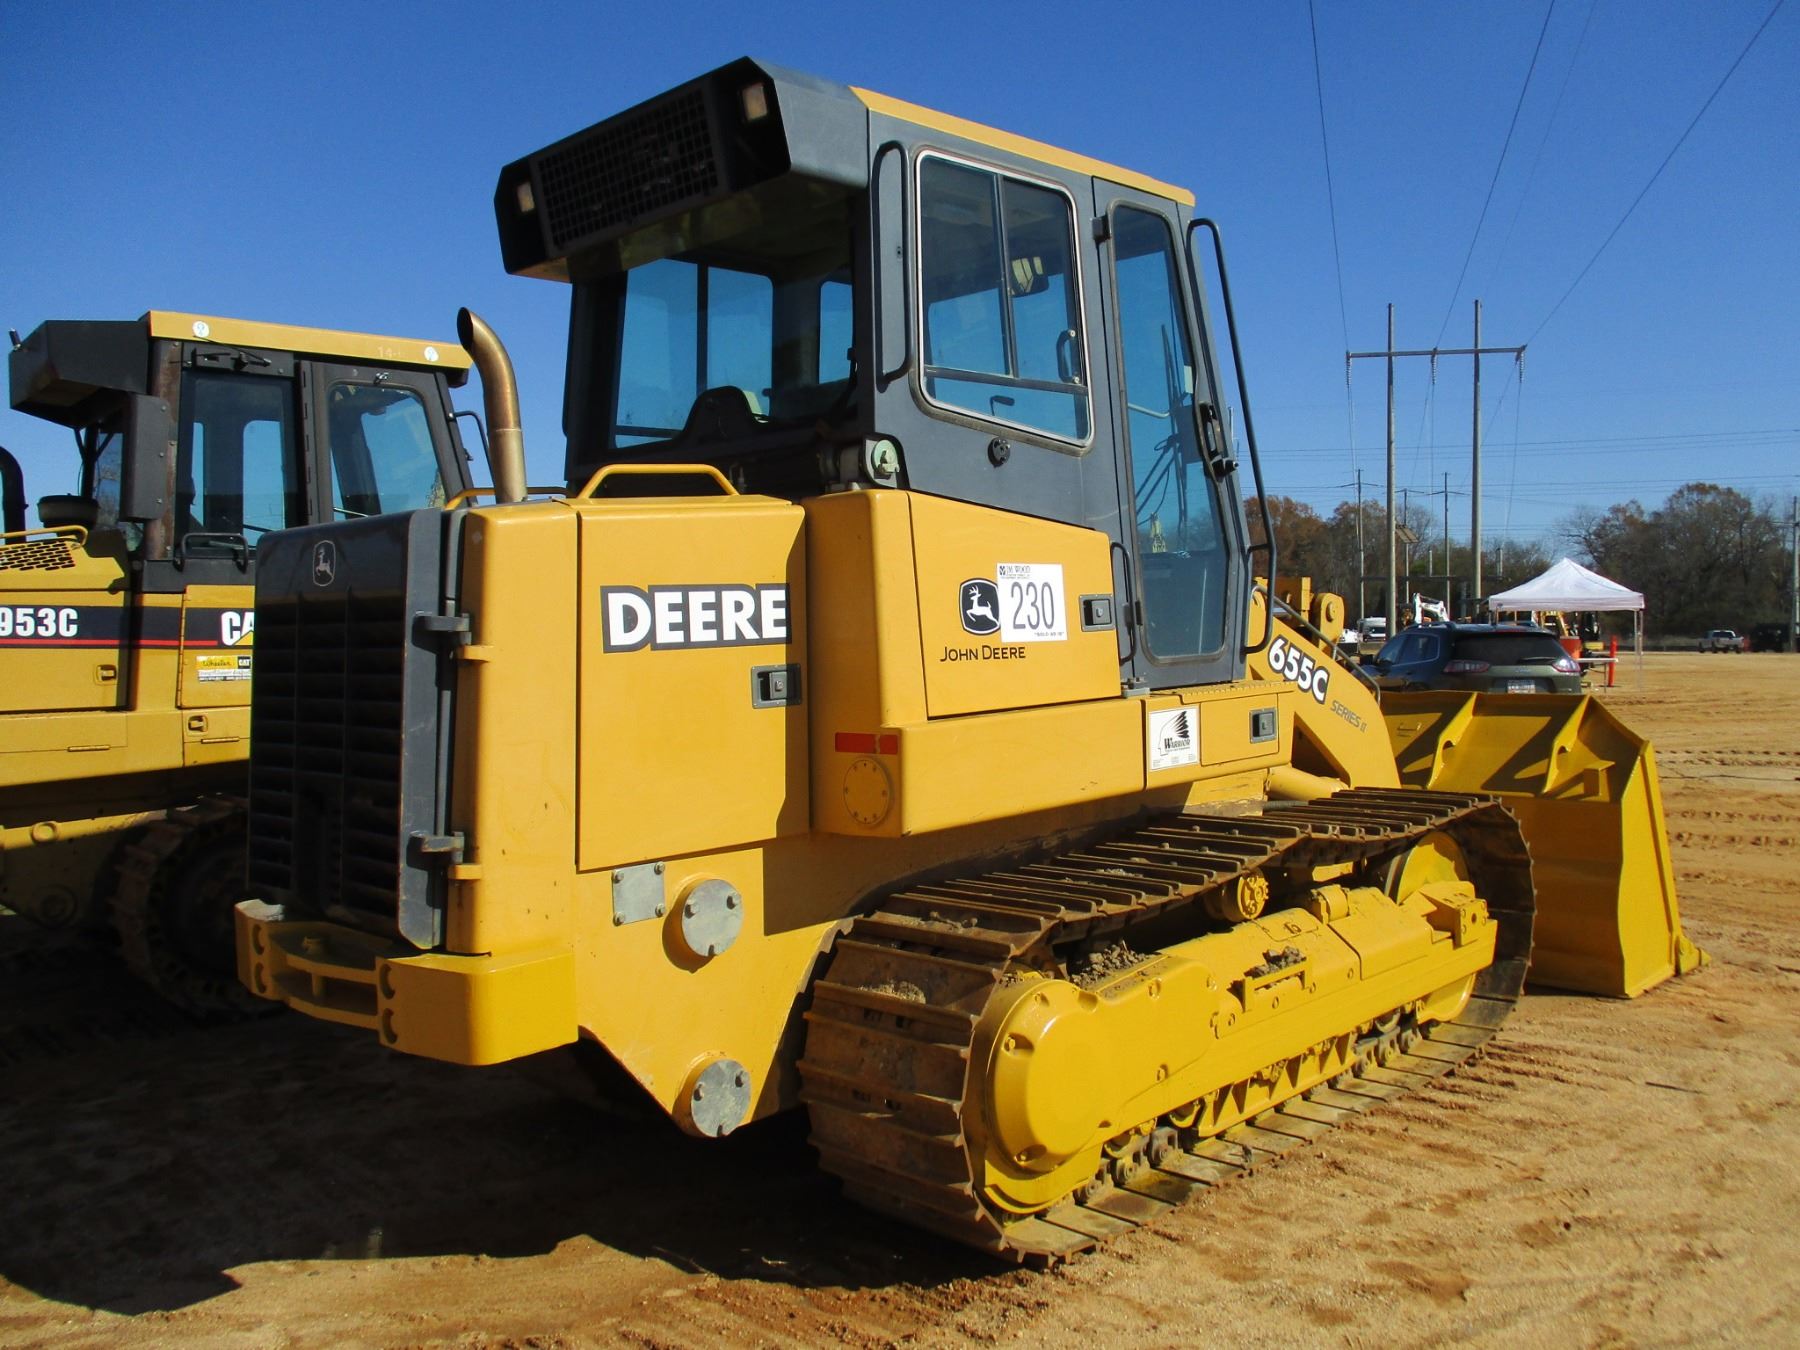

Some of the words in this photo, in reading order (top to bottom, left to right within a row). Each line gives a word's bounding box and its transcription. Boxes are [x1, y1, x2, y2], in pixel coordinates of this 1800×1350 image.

[0, 607, 79, 638] 953C
[605, 588, 788, 647] DEERE
[1010, 581, 1055, 630] 230
[1267, 637, 1329, 703] 655C
[1330, 700, 1361, 728] SERIES
[1360, 723, 1367, 733] II
